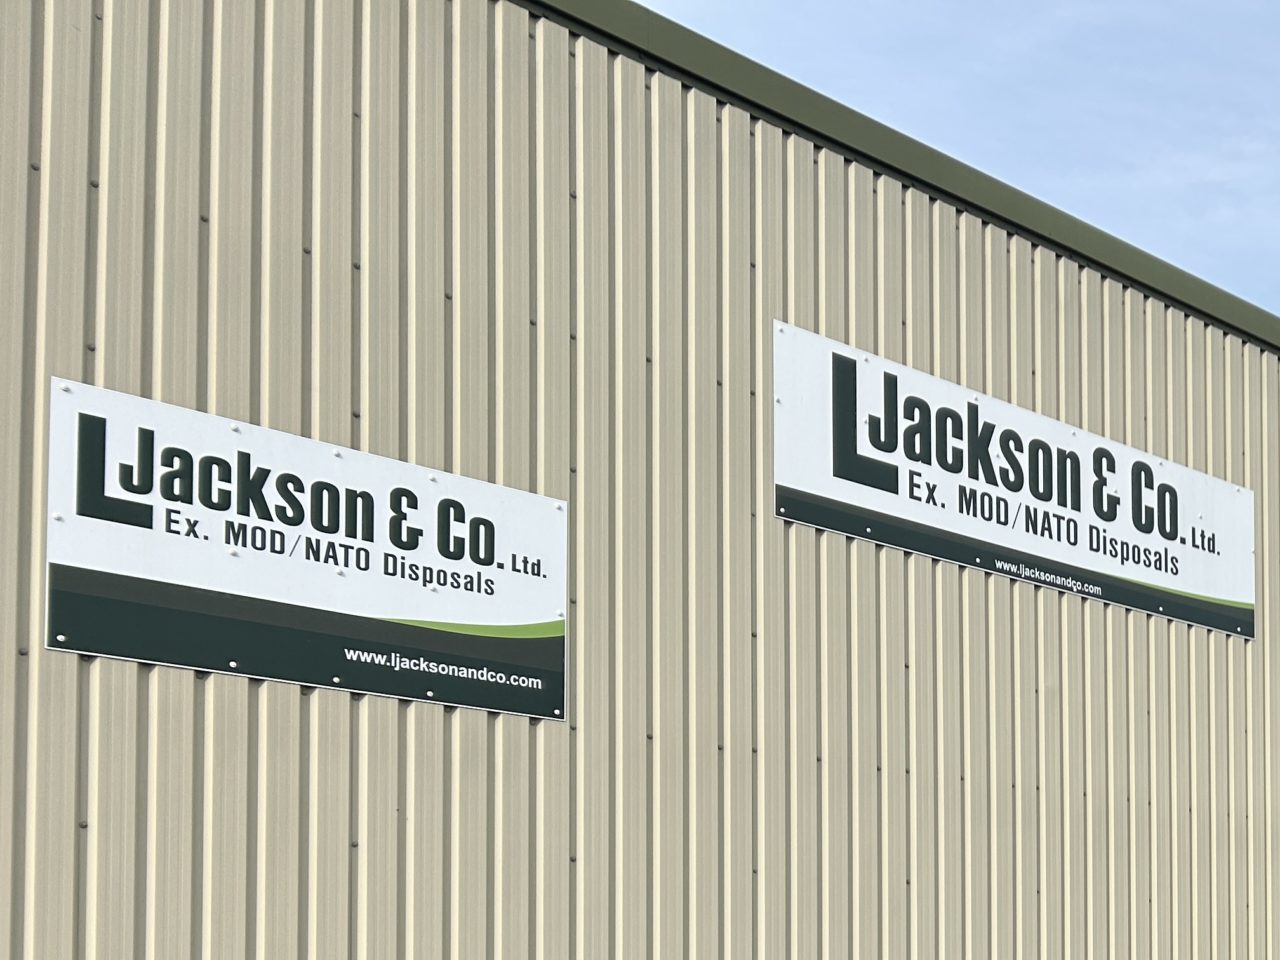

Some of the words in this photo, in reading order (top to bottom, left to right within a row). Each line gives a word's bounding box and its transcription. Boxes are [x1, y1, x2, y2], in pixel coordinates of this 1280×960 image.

[389, 488, 423, 550] &
[438, 498, 505, 570] Co.
[511, 554, 548, 579] Ltd.
[909, 469, 946, 509] Ex.
[959, 485, 1079, 546] MOD/NATO
[1089, 524, 1179, 576] Disposals
[1093, 447, 1120, 522] &
[1132, 460, 1187, 545] Co.
[1192, 526, 1221, 556] Ltd.
[166, 509, 209, 541] Ex.
[225, 521, 370, 572] MOD/NATO
[384, 552, 496, 596] Disposals
[994, 559, 1103, 595] www.ljacksonandco.com
[344, 646, 543, 690] www.ljacksonandco.com
